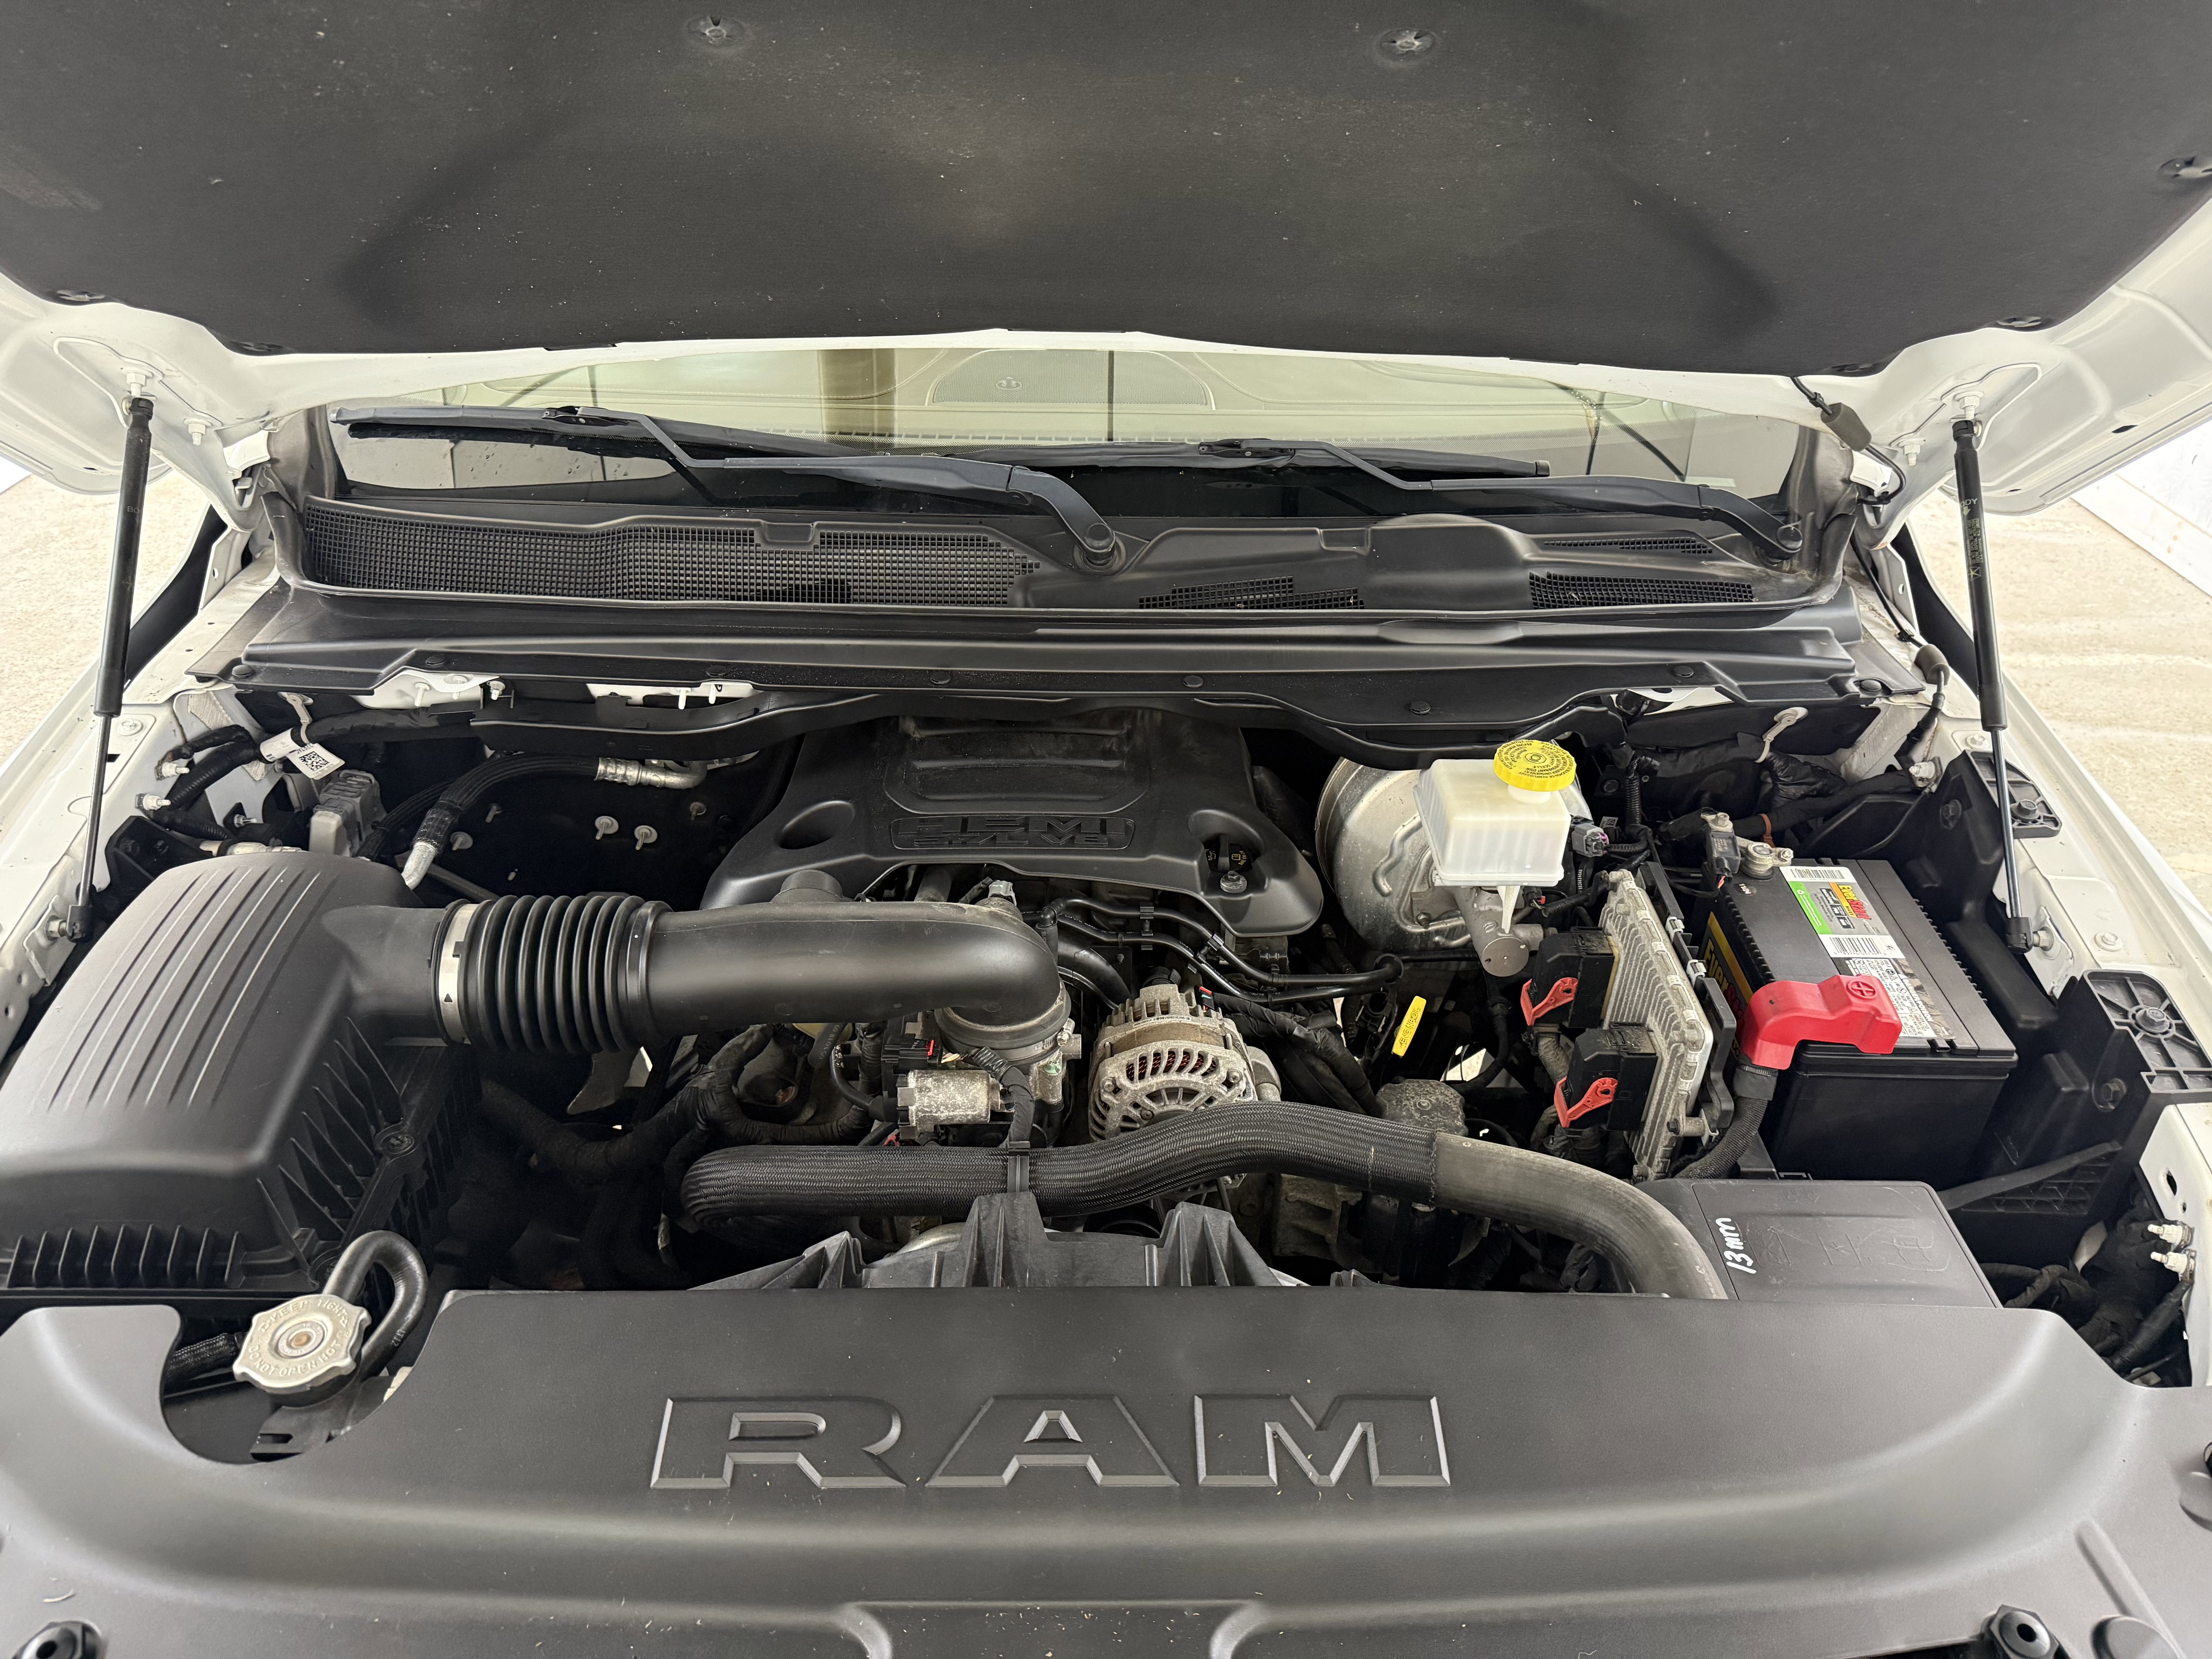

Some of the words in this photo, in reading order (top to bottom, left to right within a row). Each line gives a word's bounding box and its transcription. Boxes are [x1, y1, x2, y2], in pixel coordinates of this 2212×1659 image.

[1961, 498, 1978, 507] ODY
[1838, 884, 1872, 920] EverStart
[1716, 1218, 1757, 1274] 13mm
[270, 1300, 308, 1321] KEEP
[318, 1298, 348, 1317] TIGHT
[249, 1345, 261, 1360] DO
[318, 1340, 342, 1363] HOT
[254, 1358, 280, 1375] NOT
[279, 1360, 318, 1377] OPEN
[650, 1396, 1451, 1489] RAM
